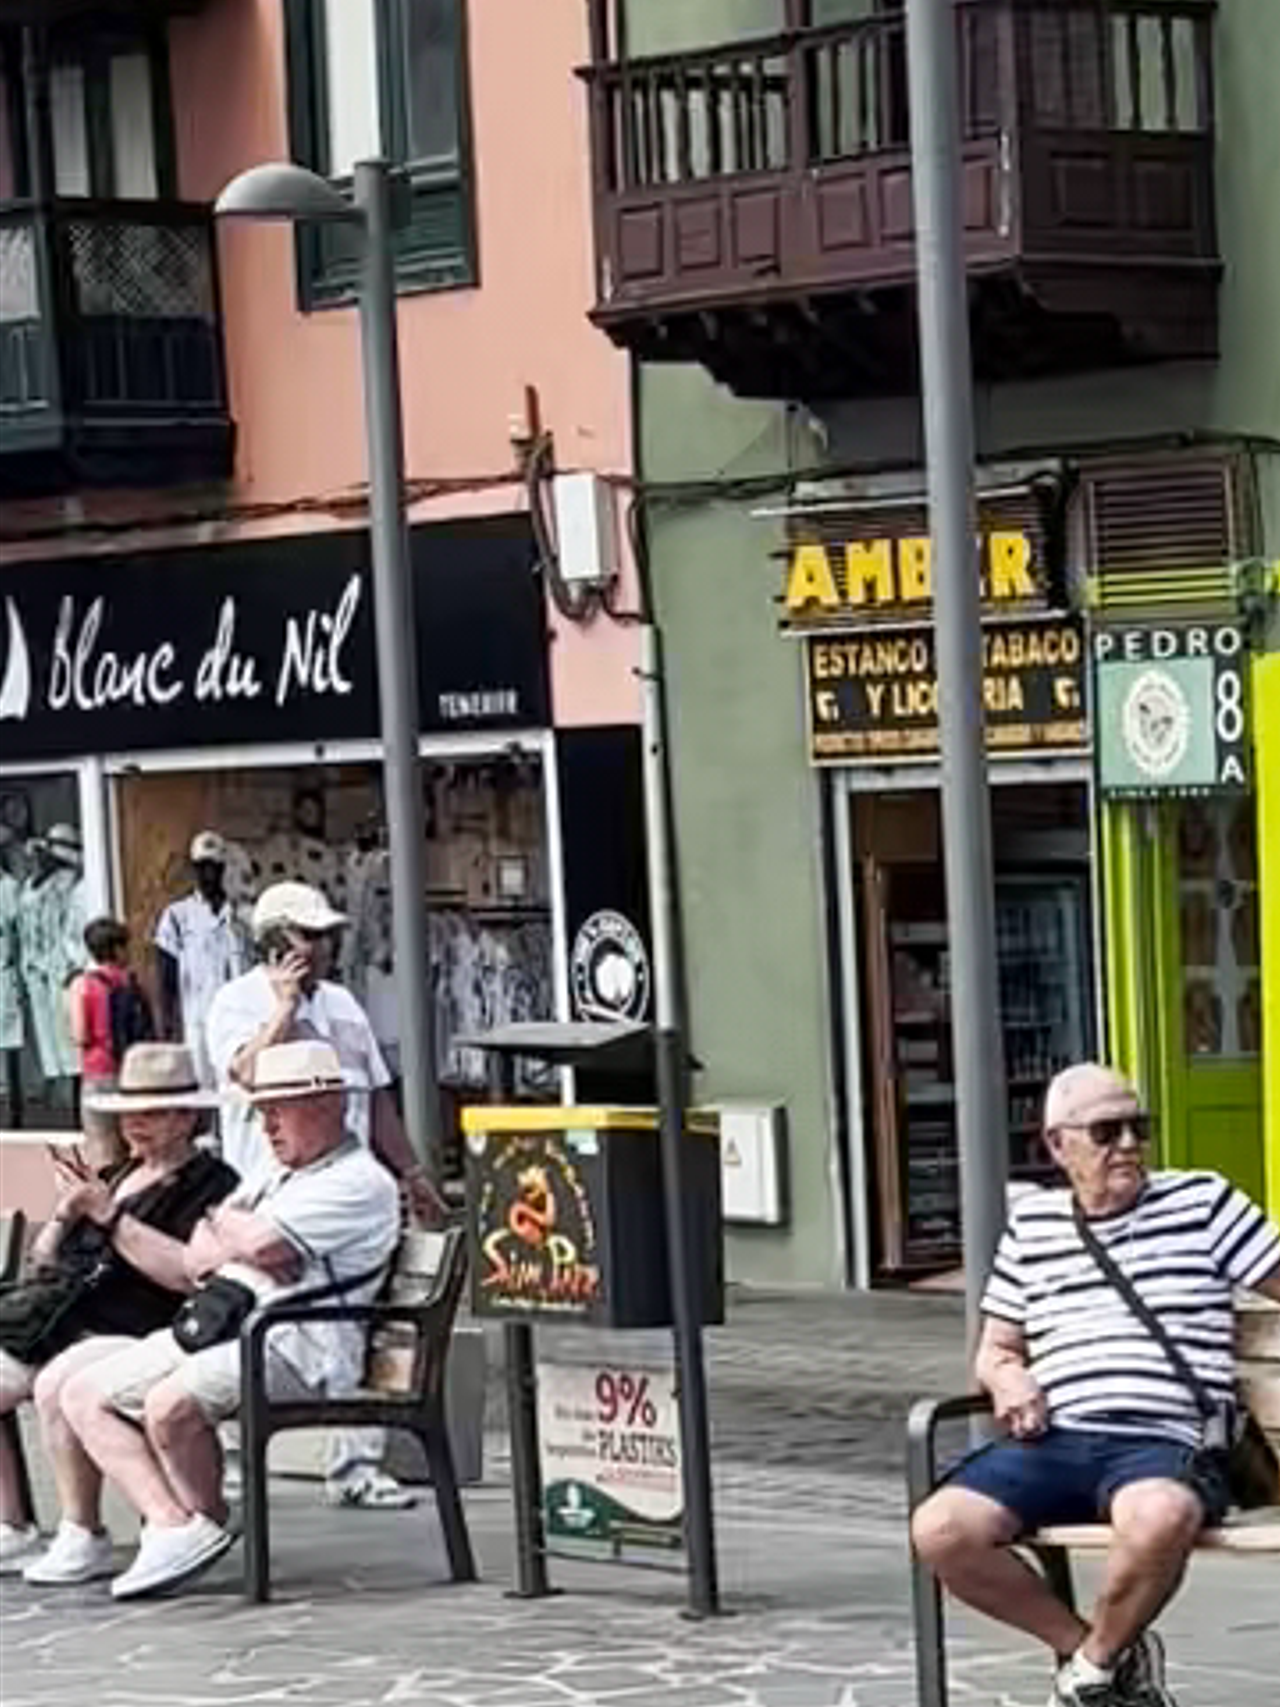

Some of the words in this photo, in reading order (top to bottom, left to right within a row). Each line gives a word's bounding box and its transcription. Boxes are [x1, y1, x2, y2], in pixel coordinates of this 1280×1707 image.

[787, 531, 1036, 608] AMBR
[48, 595, 184, 710] blanc
[195, 596, 262, 700] du
[277, 574, 362, 707] Nil
[813, 639, 928, 679] ESTANCO
[1093, 626, 1242, 661] PEDRO
[595, 1372, 658, 1427] 9%
